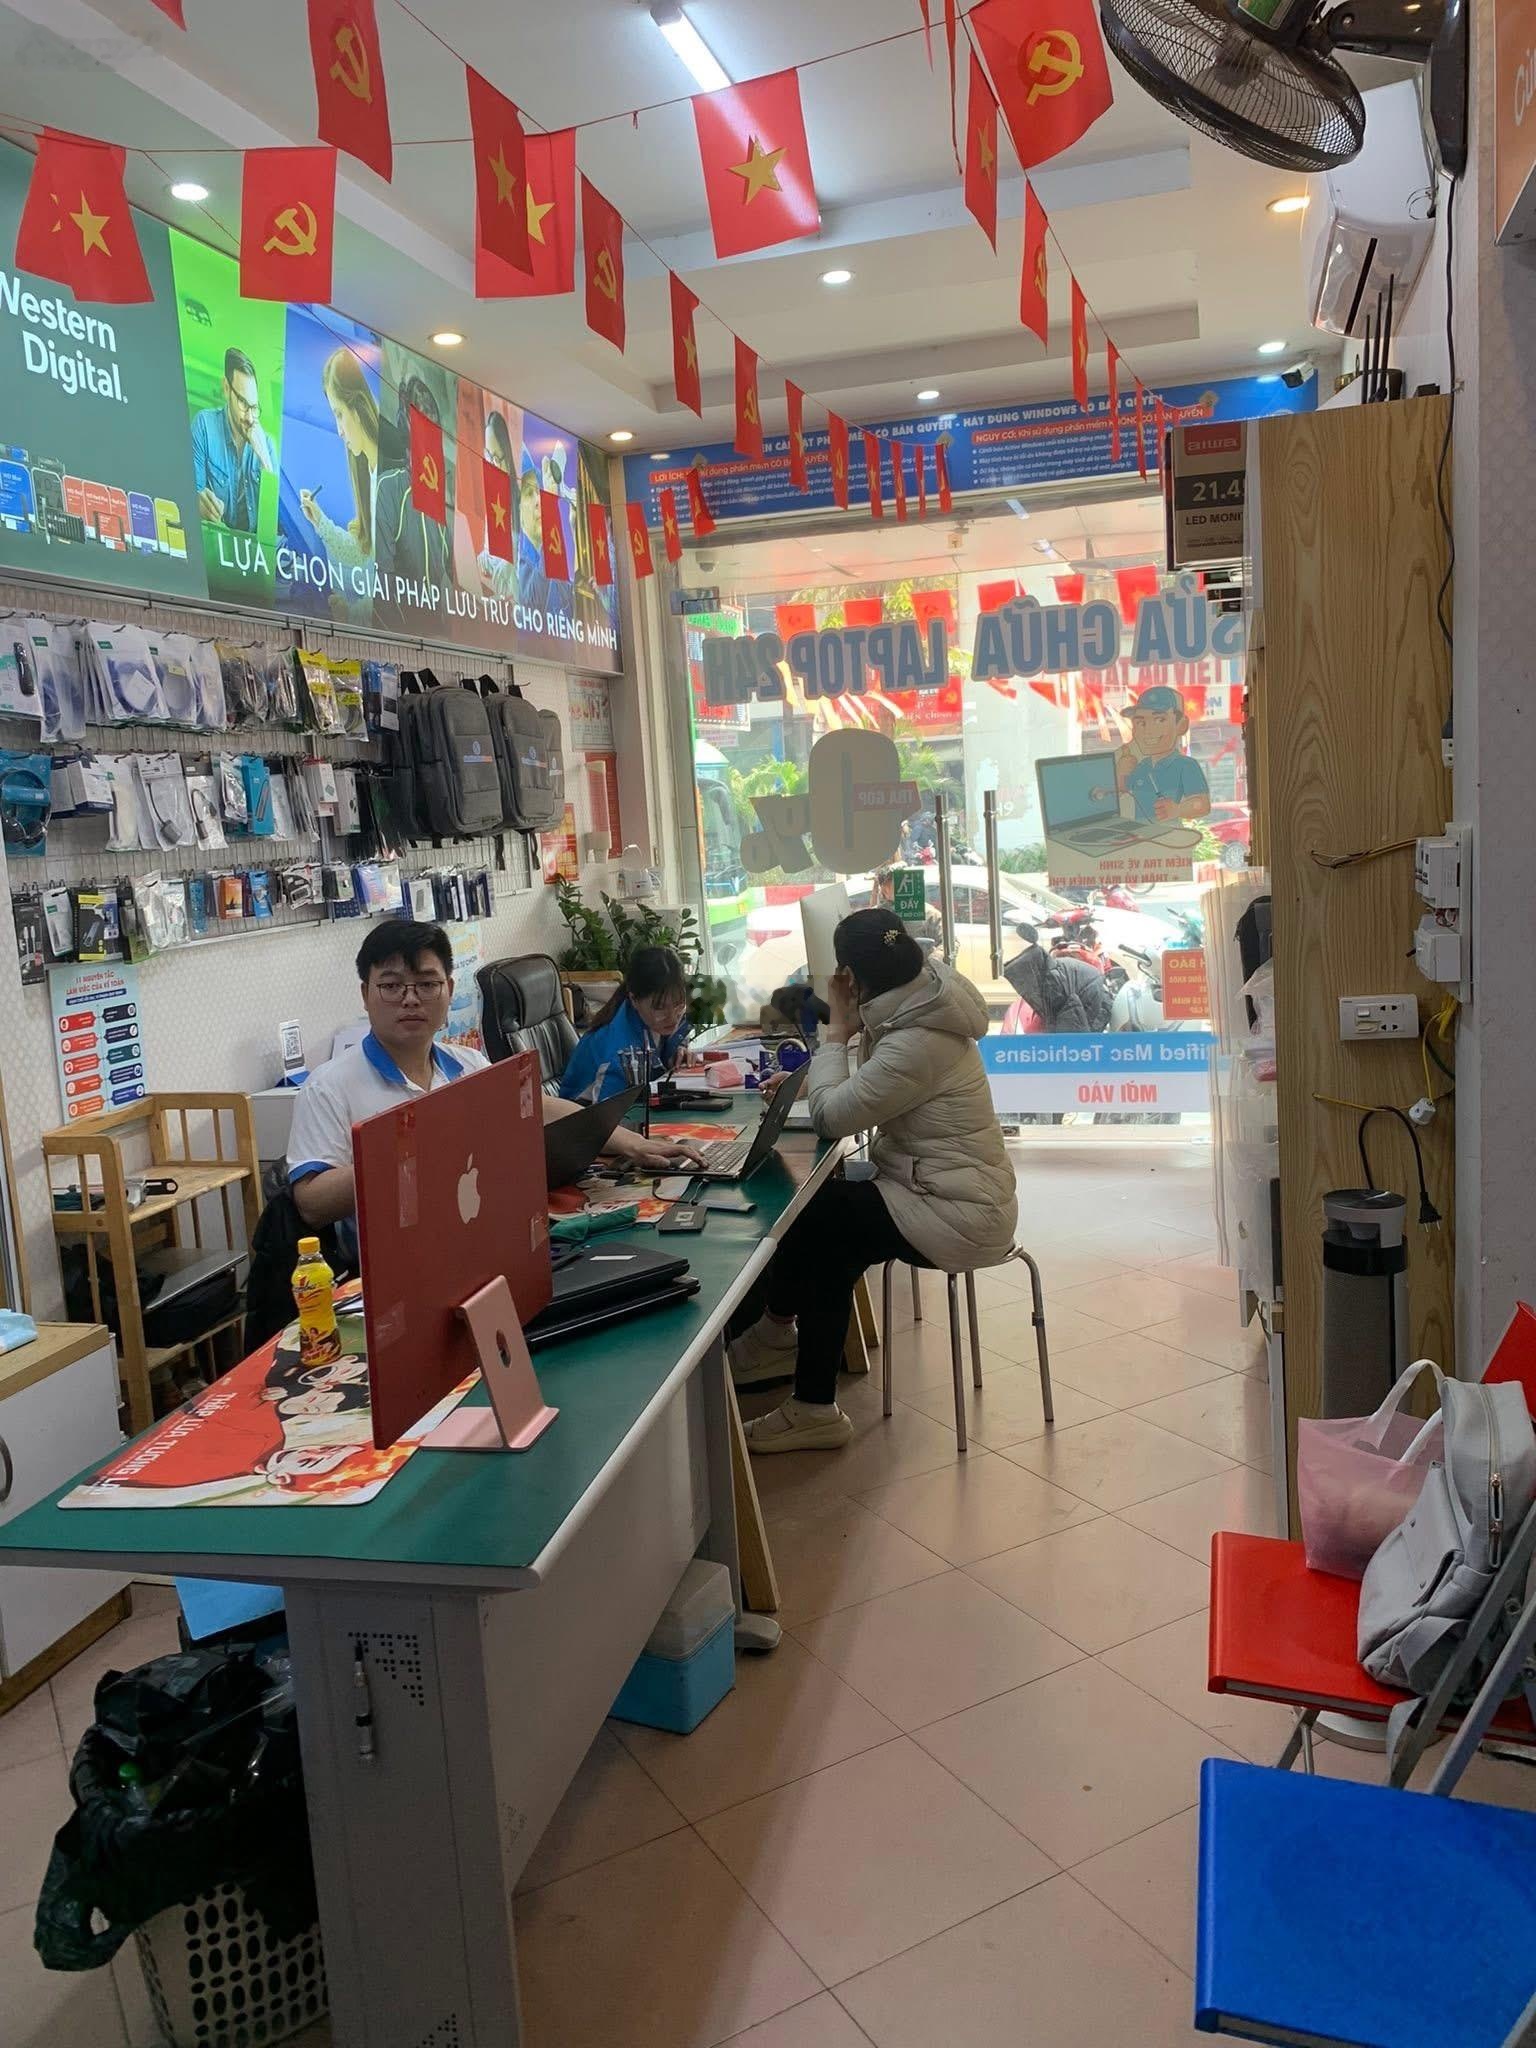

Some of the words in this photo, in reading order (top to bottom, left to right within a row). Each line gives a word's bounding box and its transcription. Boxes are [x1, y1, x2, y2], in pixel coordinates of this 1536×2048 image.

[1022, 404, 1078, 421] WINDOWS
[1185, 514, 1208, 526] LED
[217, 532, 270, 576] LỰA
[276, 547, 346, 593] CHỌN
[351, 562, 391, 601] GIẢI
[395, 575, 441, 612] PHÁP
[445, 587, 478, 619] LƯU
[480, 593, 510, 627] TRỮ
[513, 602, 544, 634] CHO
[547, 609, 585, 643] RIÊNG
[587, 619, 618, 650] MÌNH
